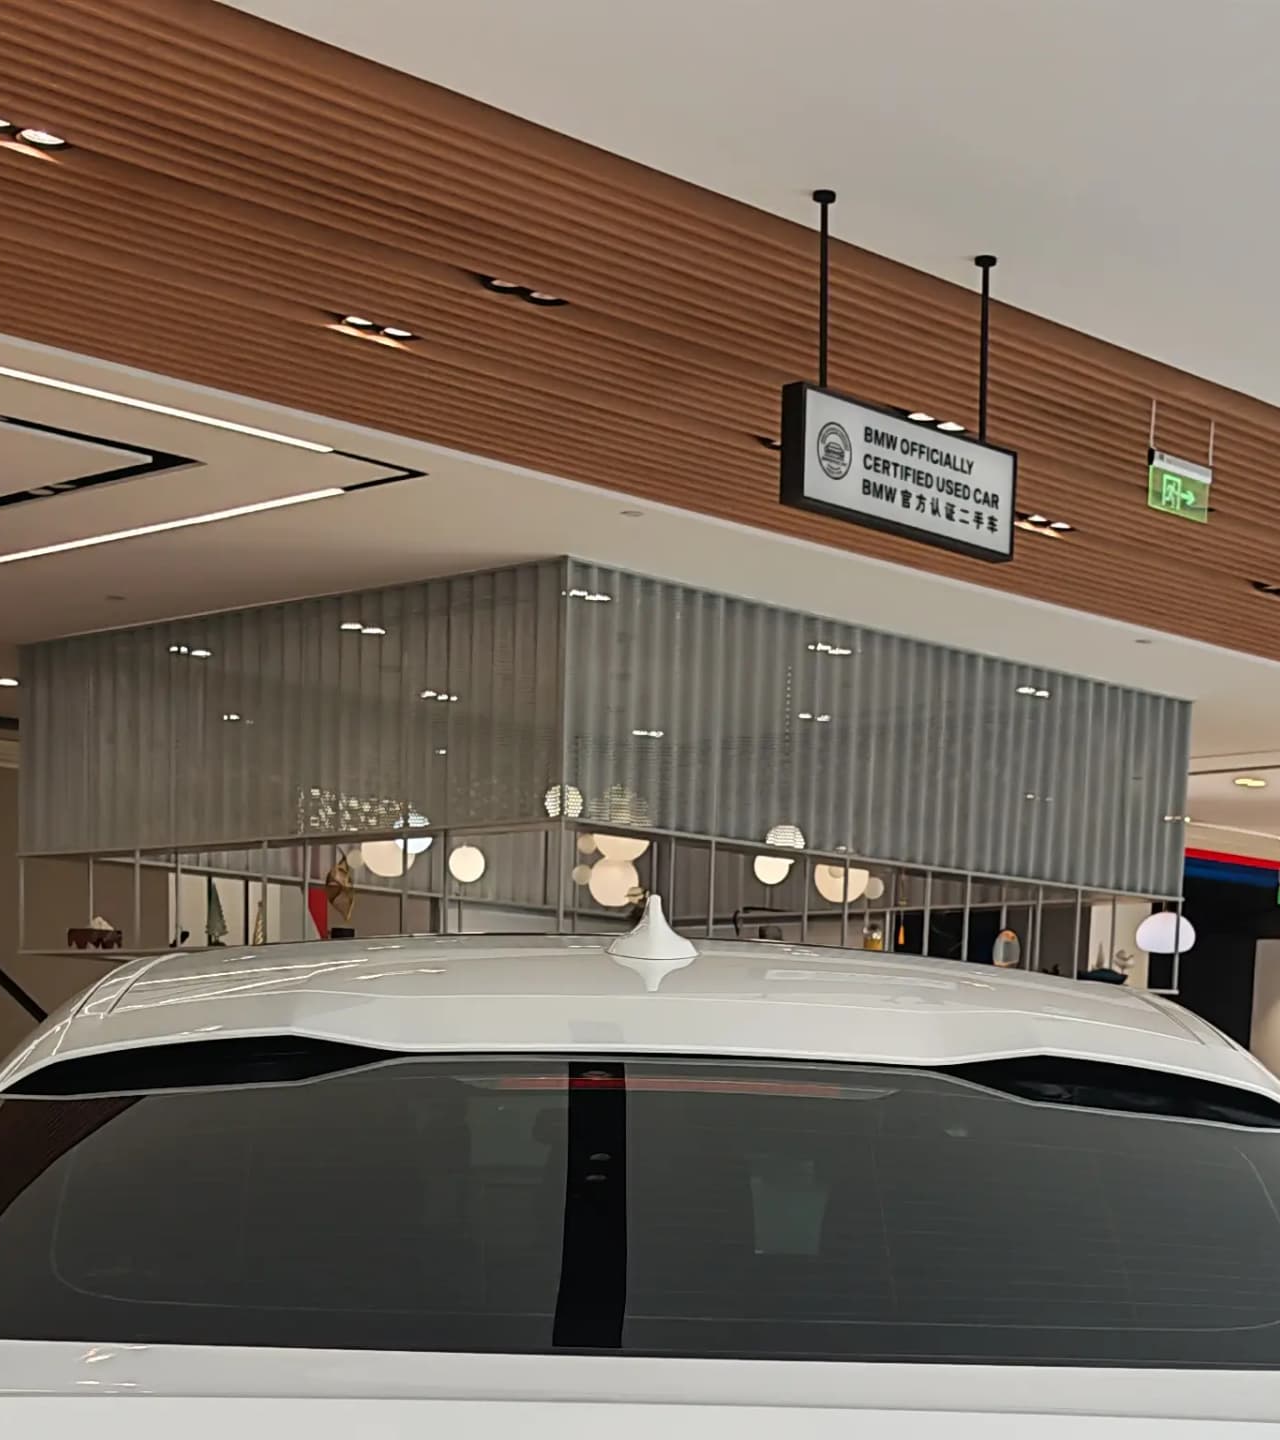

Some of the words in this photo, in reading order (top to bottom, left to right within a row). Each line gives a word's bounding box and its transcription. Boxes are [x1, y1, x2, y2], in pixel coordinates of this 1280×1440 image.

[864, 426, 898, 451] BMW
[900, 438, 974, 475] OFFICIALLY
[862, 478, 897, 503] BMW
[900, 489, 999, 534] 官方认证二手车
[863, 453, 934, 489] CERTIFIED
[936, 476, 971, 501] USED
[973, 488, 1000, 510] CAR
